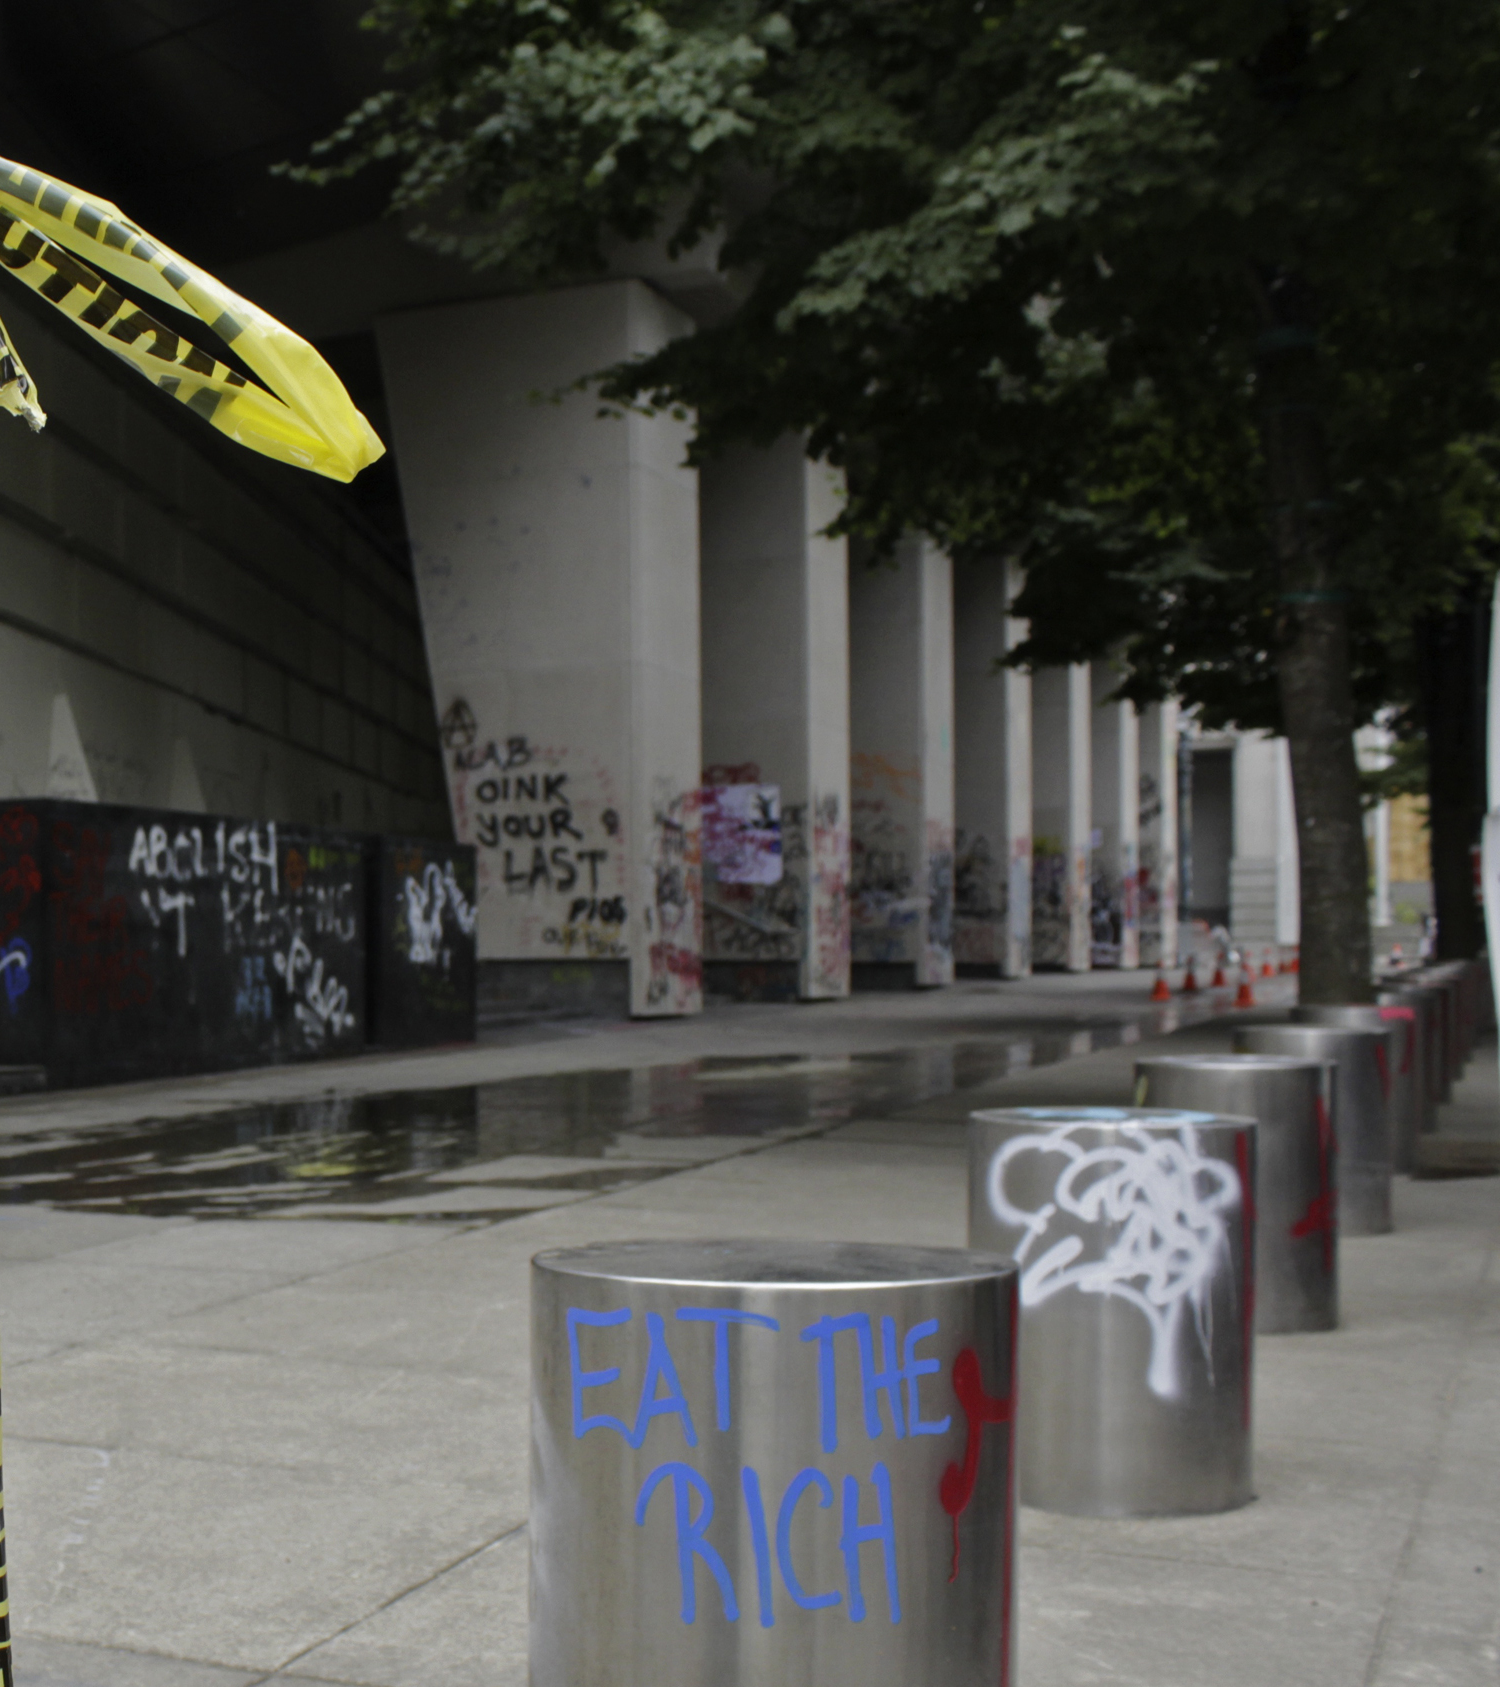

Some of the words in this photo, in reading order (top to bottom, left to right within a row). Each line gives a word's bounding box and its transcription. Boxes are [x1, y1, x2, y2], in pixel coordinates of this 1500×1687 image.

[476, 773, 568, 804] OINK
[129, 820, 281, 896] ABOLISH
[476, 809, 583, 848] YOUR
[502, 848, 608, 893] LAST
[566, 1306, 781, 1449] EAT
[800, 1311, 953, 1454] THE
[635, 1461, 902, 1629] RICH
